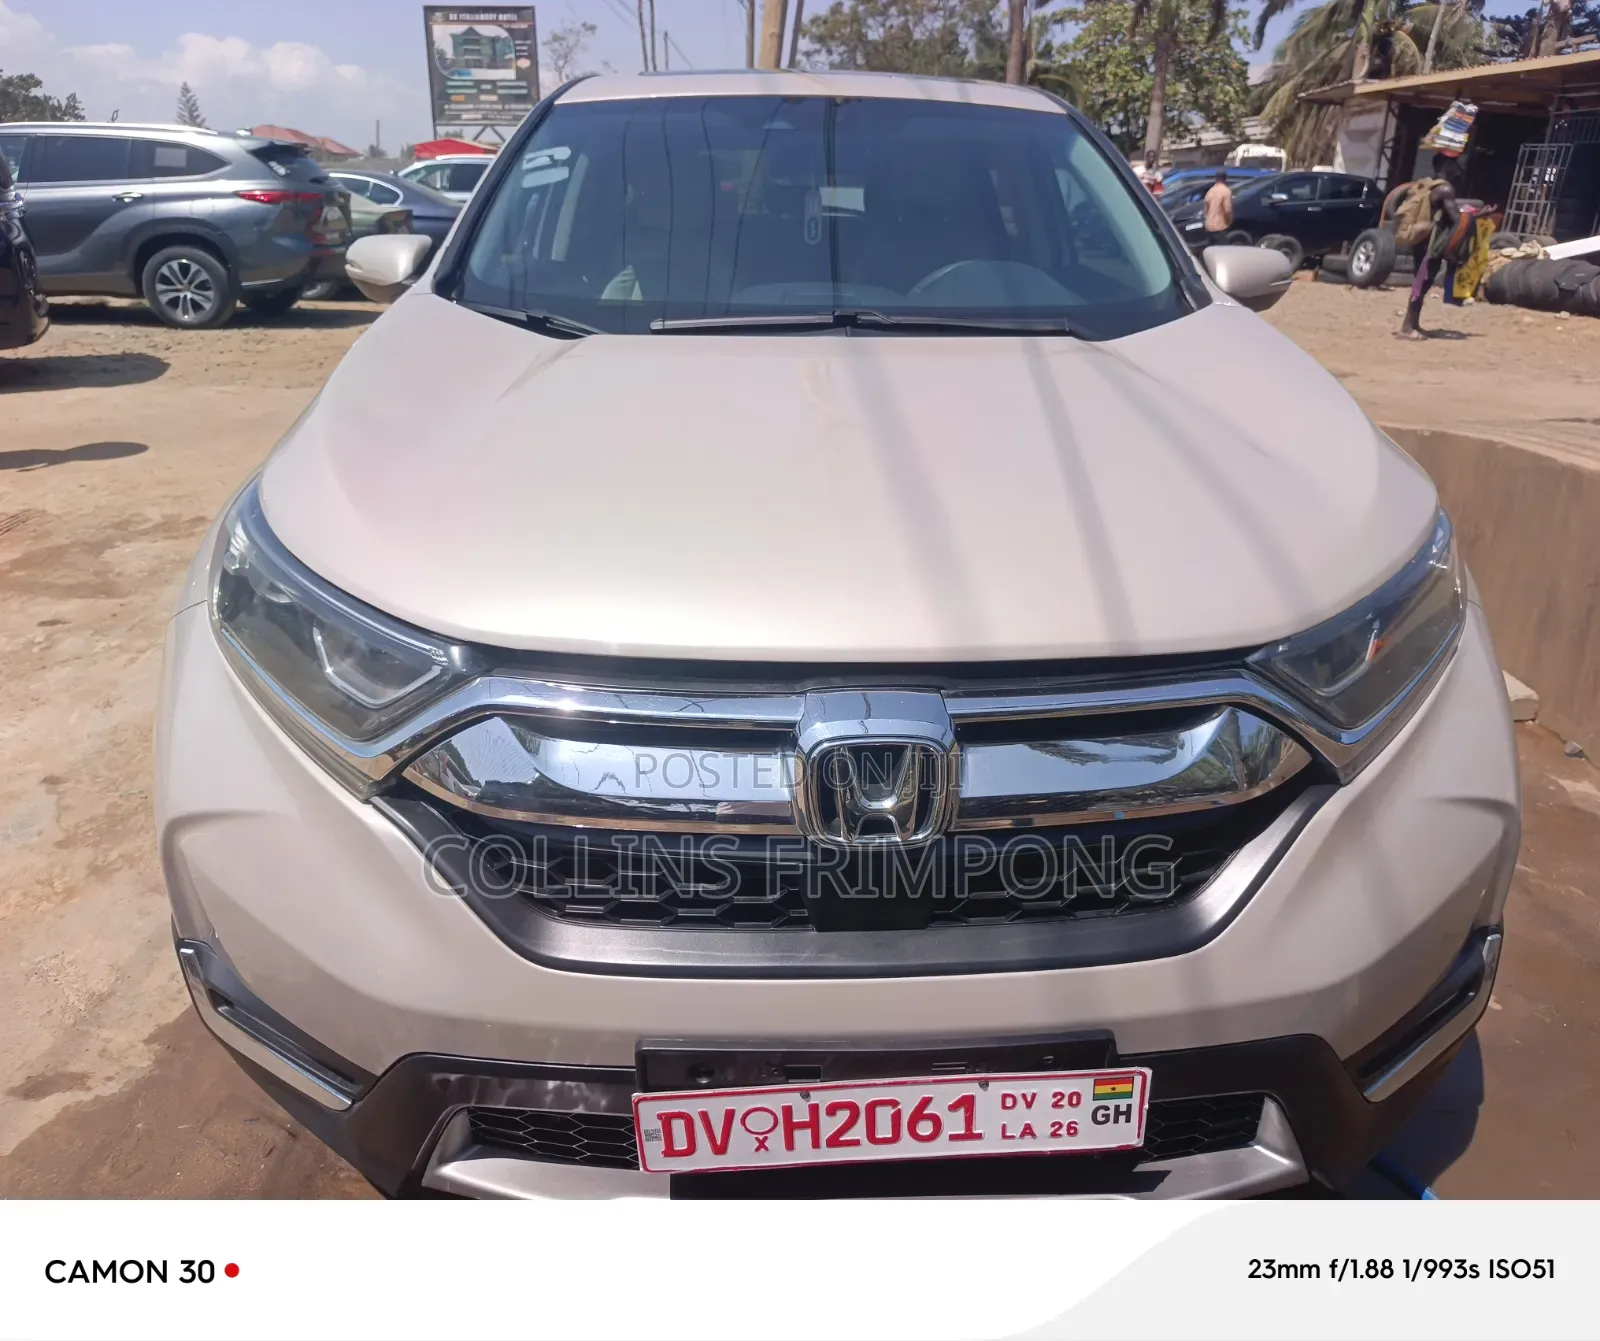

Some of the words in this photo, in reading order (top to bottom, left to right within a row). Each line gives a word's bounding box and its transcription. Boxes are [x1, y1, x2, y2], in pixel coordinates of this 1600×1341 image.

[1001, 1092, 1037, 1110] DV
[1051, 1091, 1082, 1108] 20
[1091, 1103, 1132, 1125] GH
[1001, 1123, 1036, 1139] LA
[1050, 1121, 1079, 1138] 26
